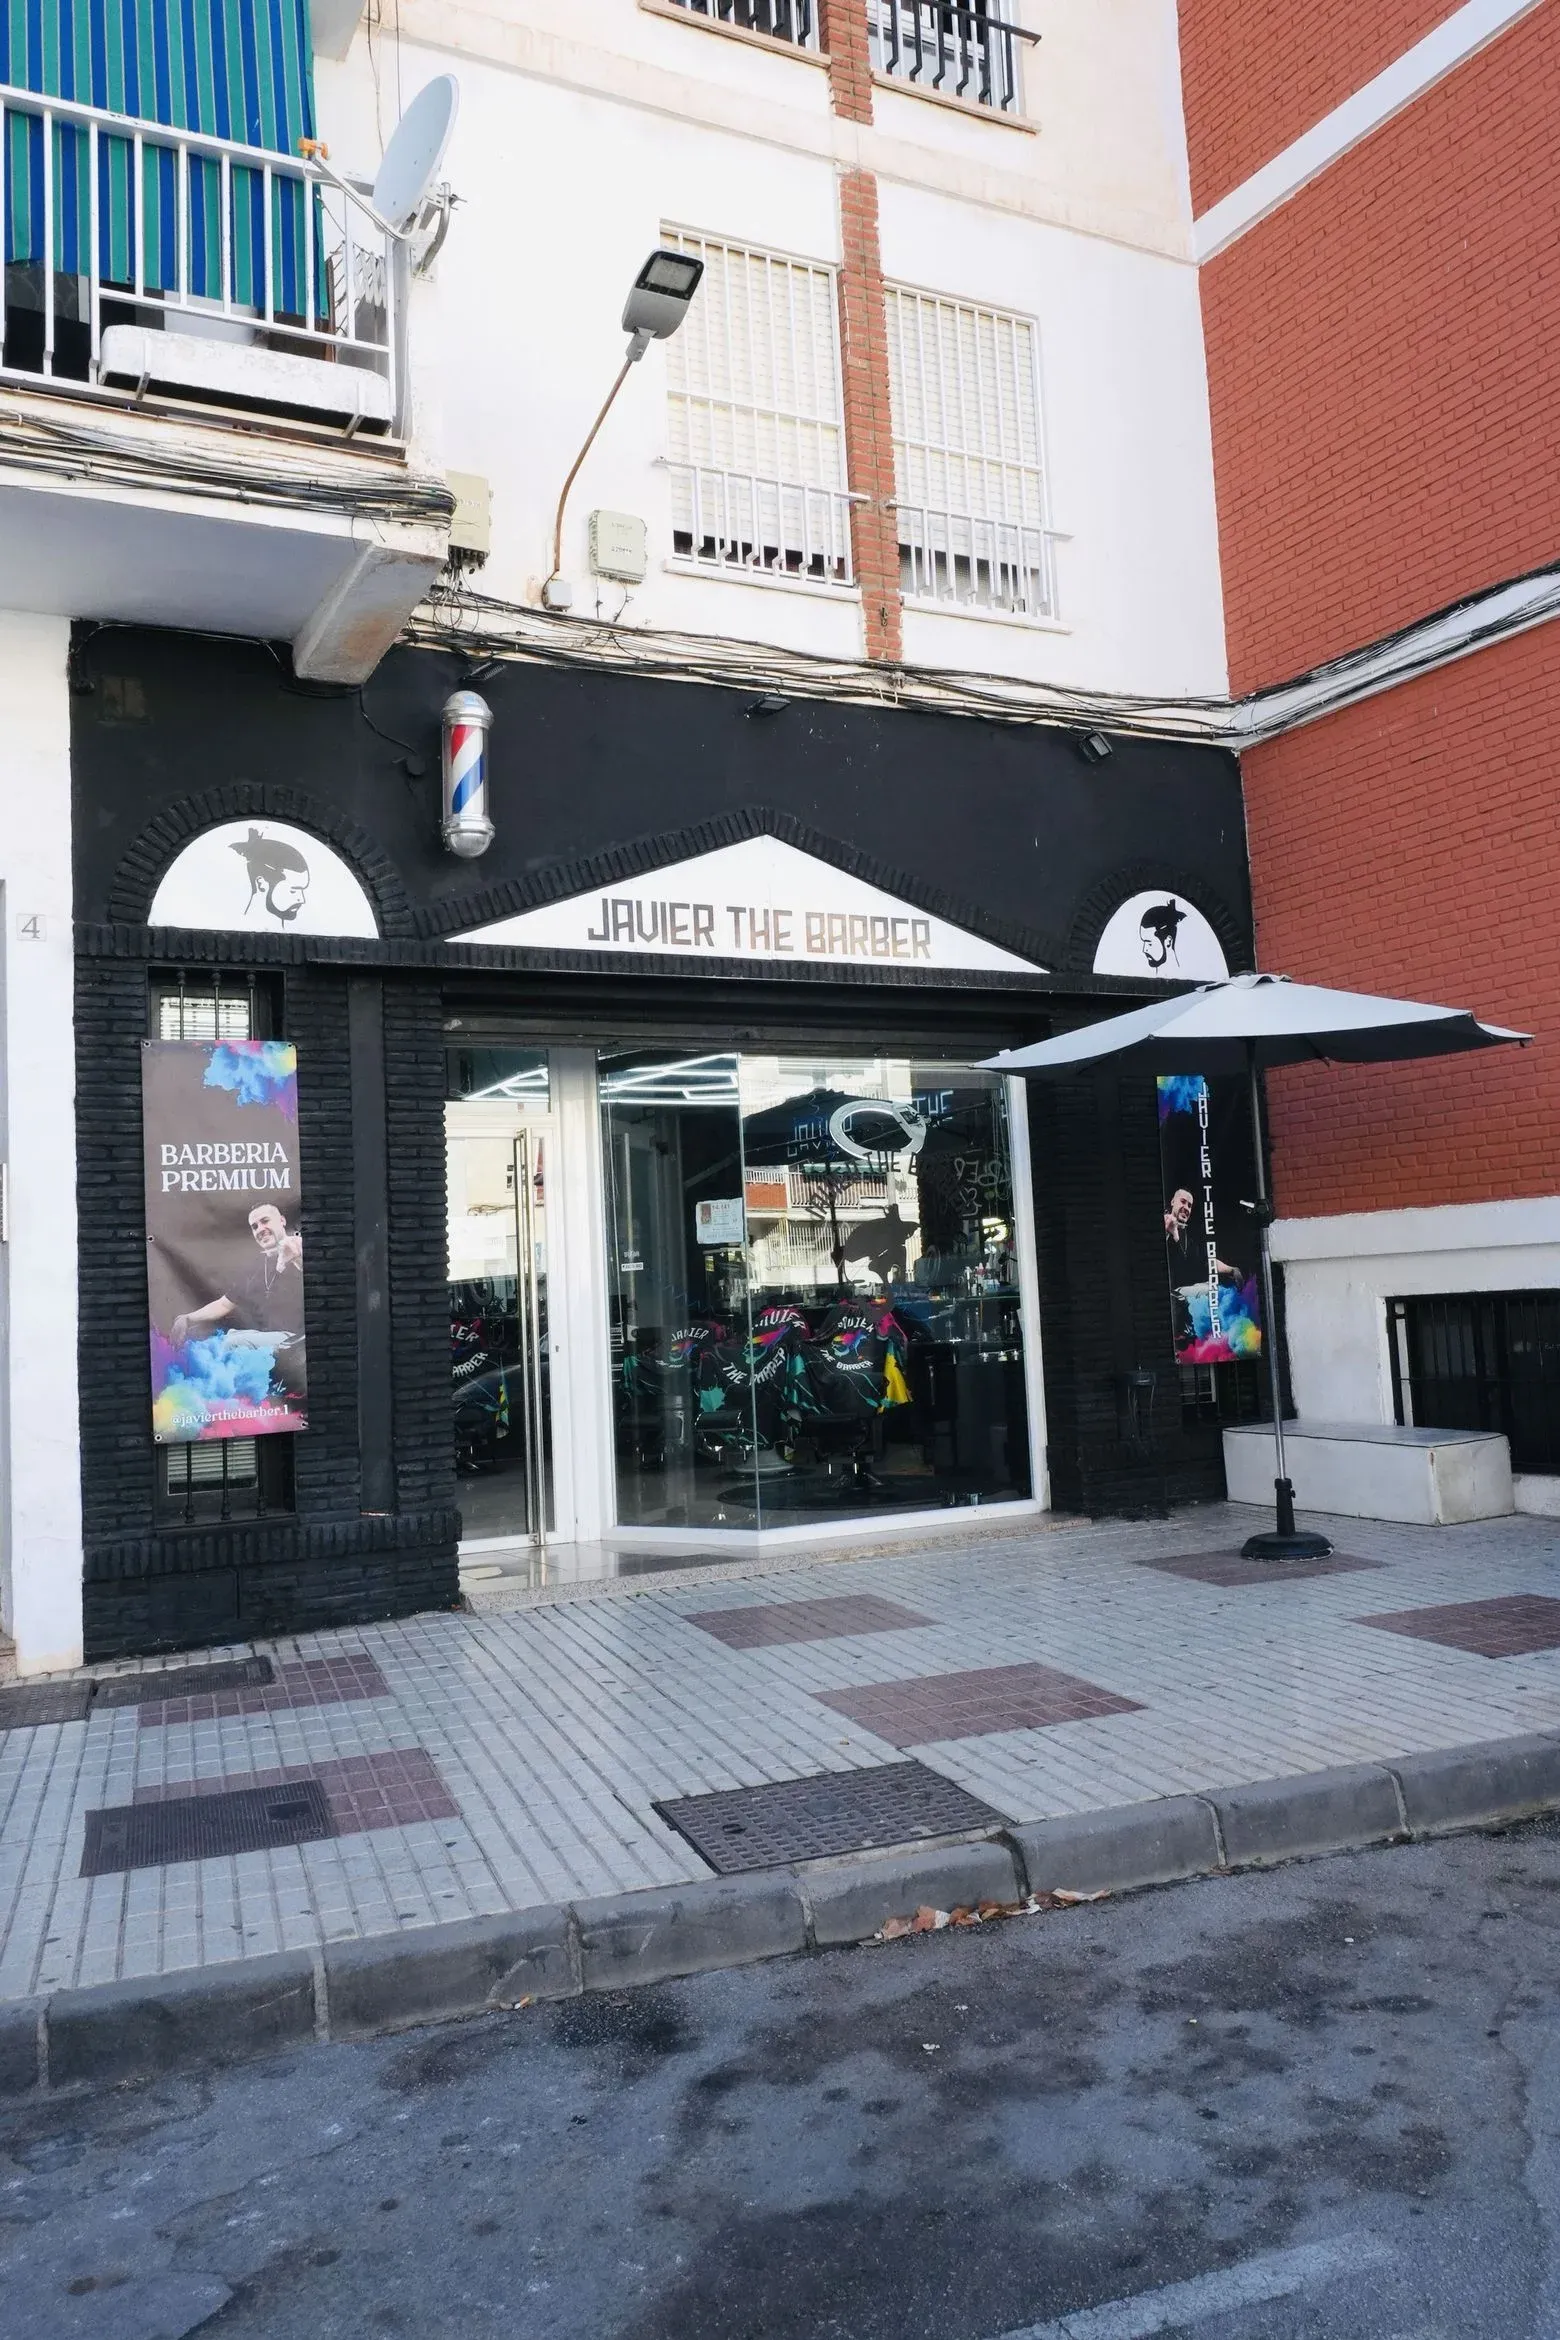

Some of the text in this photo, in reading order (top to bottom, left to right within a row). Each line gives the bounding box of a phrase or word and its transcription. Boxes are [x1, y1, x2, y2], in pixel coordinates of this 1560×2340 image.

[21, 916, 40, 939] 4
[588, 898, 930, 959] JAVIER THE BARBER
[160, 1142, 289, 1166] BARBERIA
[161, 1167, 291, 1193] PREMIUM
[1198, 1082, 1221, 1339] JAVIER THE BARBER
[452, 1352, 489, 1378] ARBER
[722, 1362, 748, 1385] THE
